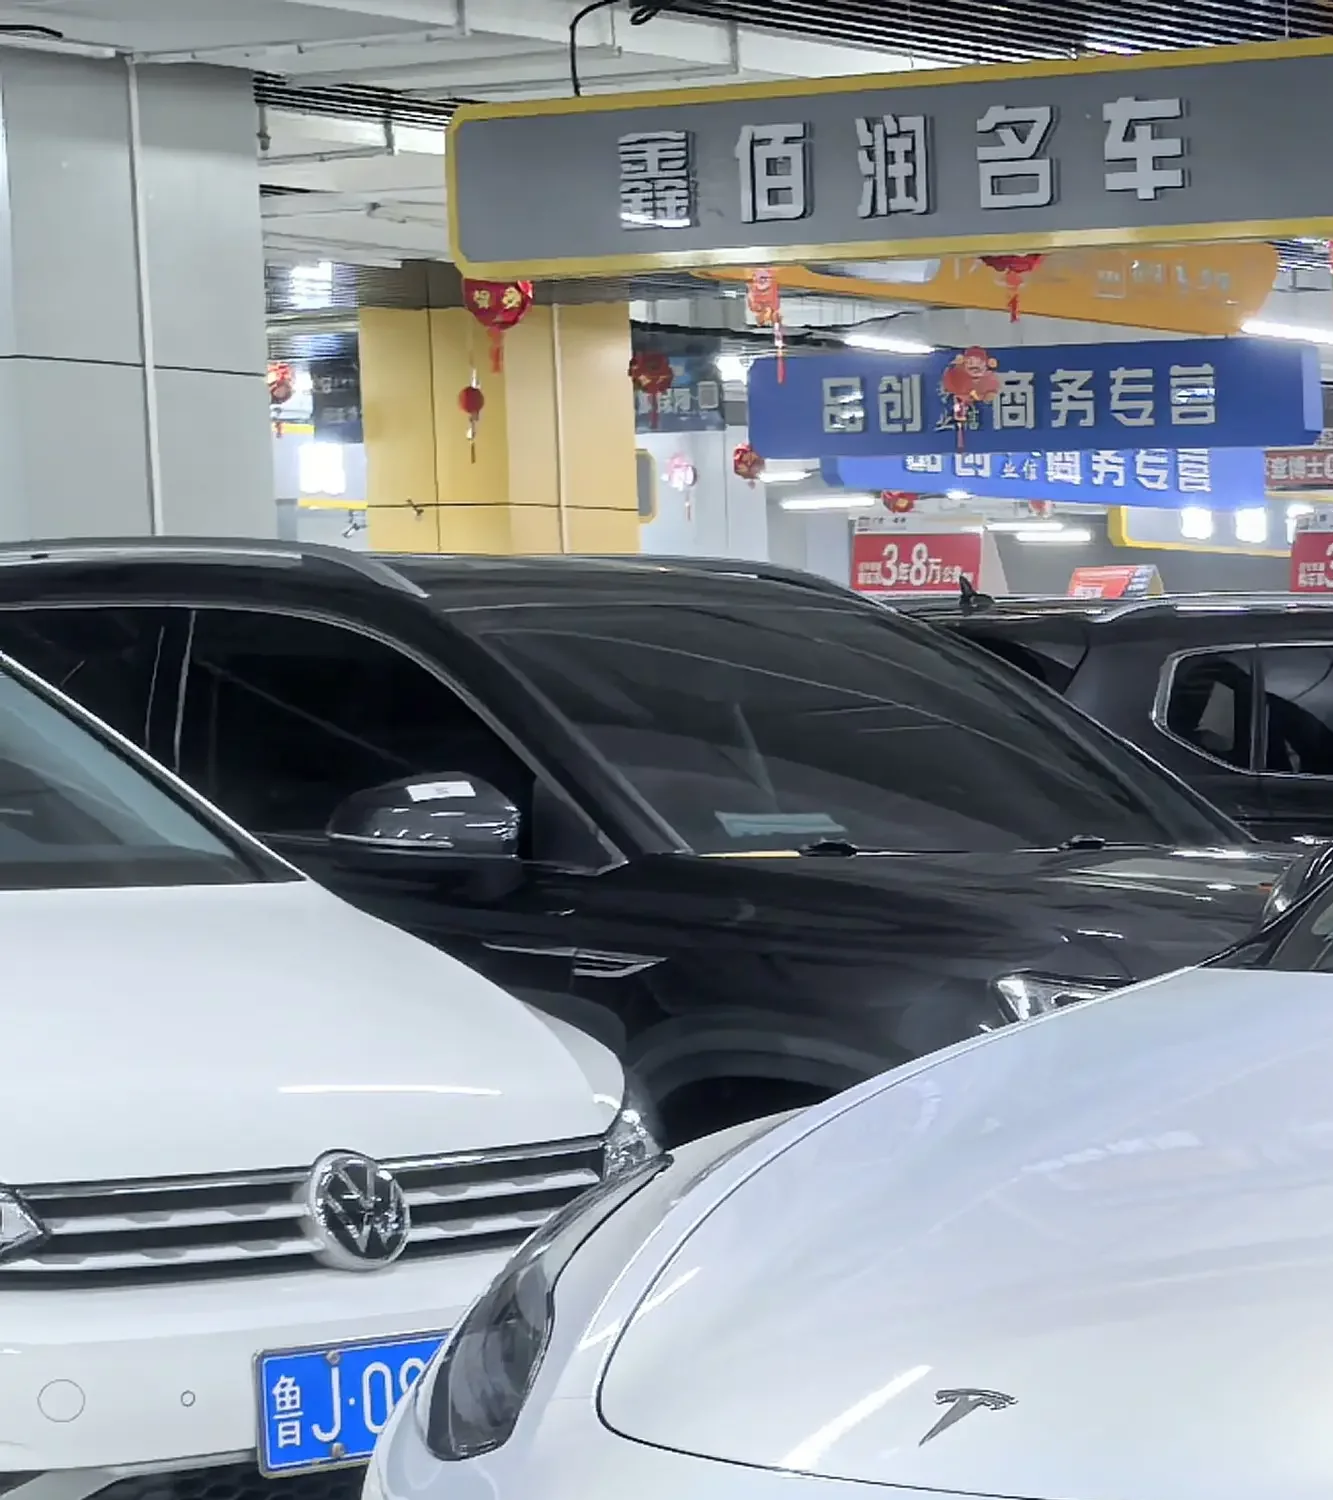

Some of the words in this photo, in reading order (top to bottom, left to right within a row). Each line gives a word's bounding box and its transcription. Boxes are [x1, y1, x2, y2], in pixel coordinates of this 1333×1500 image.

[619, 97, 1188, 230] 鑫佰润名车
[992, 363, 1217, 431] 商务专营
